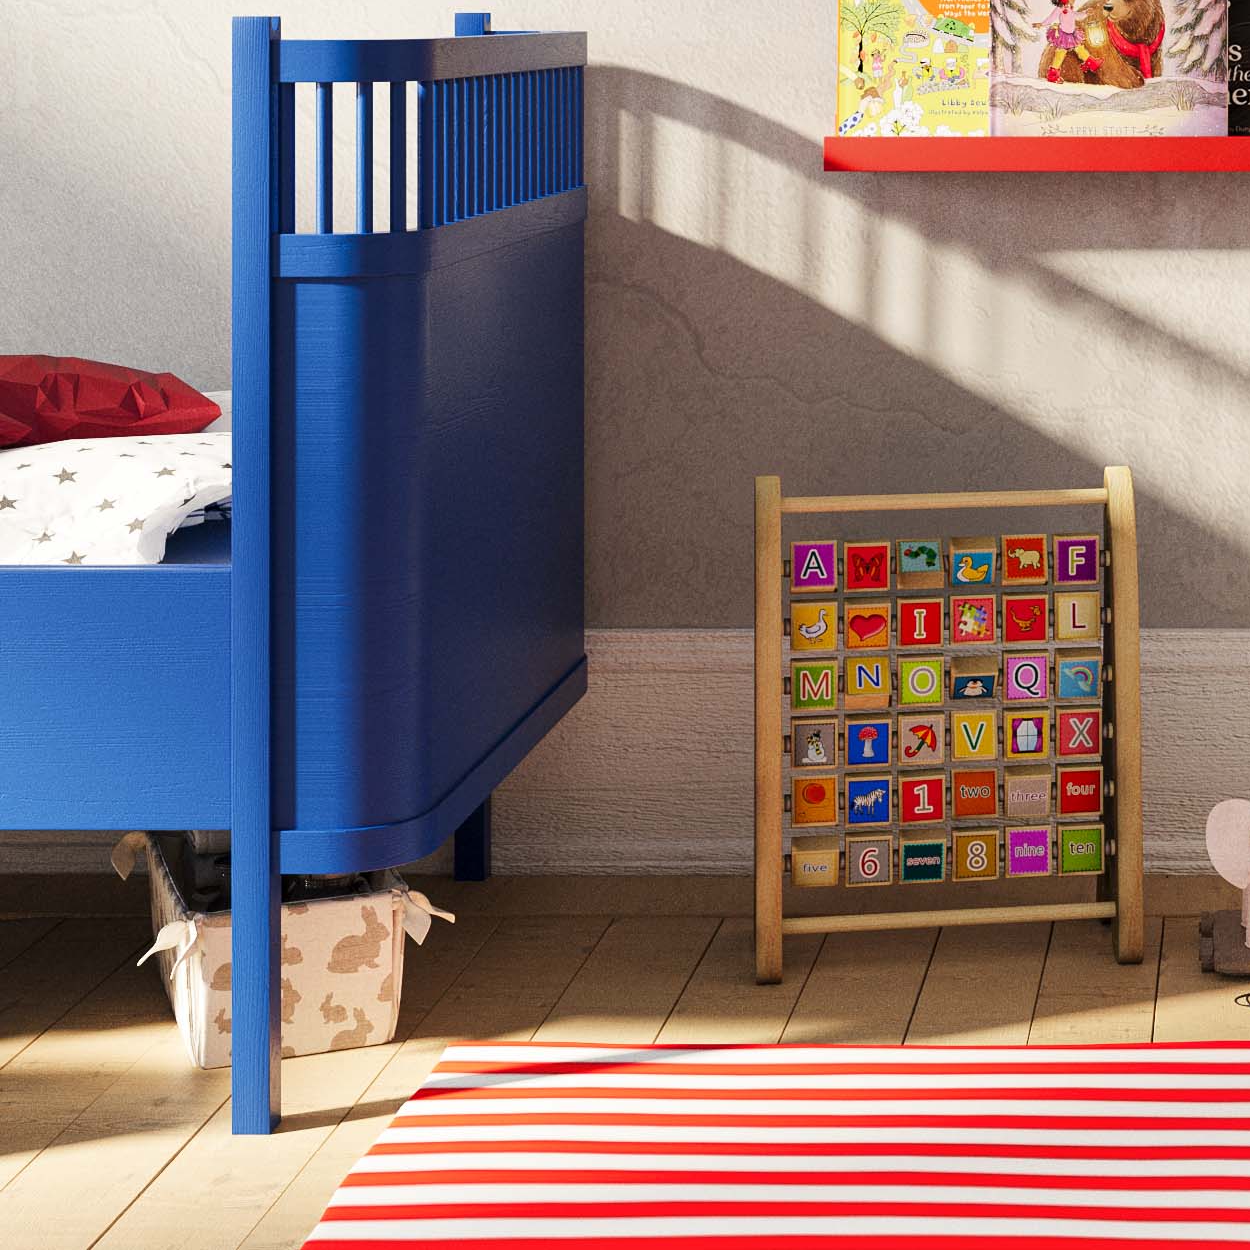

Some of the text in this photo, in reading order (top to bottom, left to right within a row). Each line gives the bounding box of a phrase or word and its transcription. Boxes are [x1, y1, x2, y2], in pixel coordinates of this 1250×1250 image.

[801, 549, 827, 579] A
[1068, 546, 1086, 575] F
[913, 608, 927, 639] I
[1071, 602, 1086, 629] L
[800, 670, 831, 699] M
[856, 664, 880, 689] N
[909, 666, 936, 694] O
[1013, 661, 1040, 696] Q
[961, 722, 985, 751] V
[1069, 717, 1093, 748] X
[914, 784, 933, 813] 1
[959, 783, 991, 799] two
[1010, 789, 1047, 802] three
[1066, 782, 1096, 796] four
[905, 856, 940, 867] seven
[966, 841, 987, 871] 8
[1014, 844, 1045, 857] nine
[1069, 841, 1095, 855] ten
[802, 862, 828, 873] five
[859, 848, 880, 877] 6
